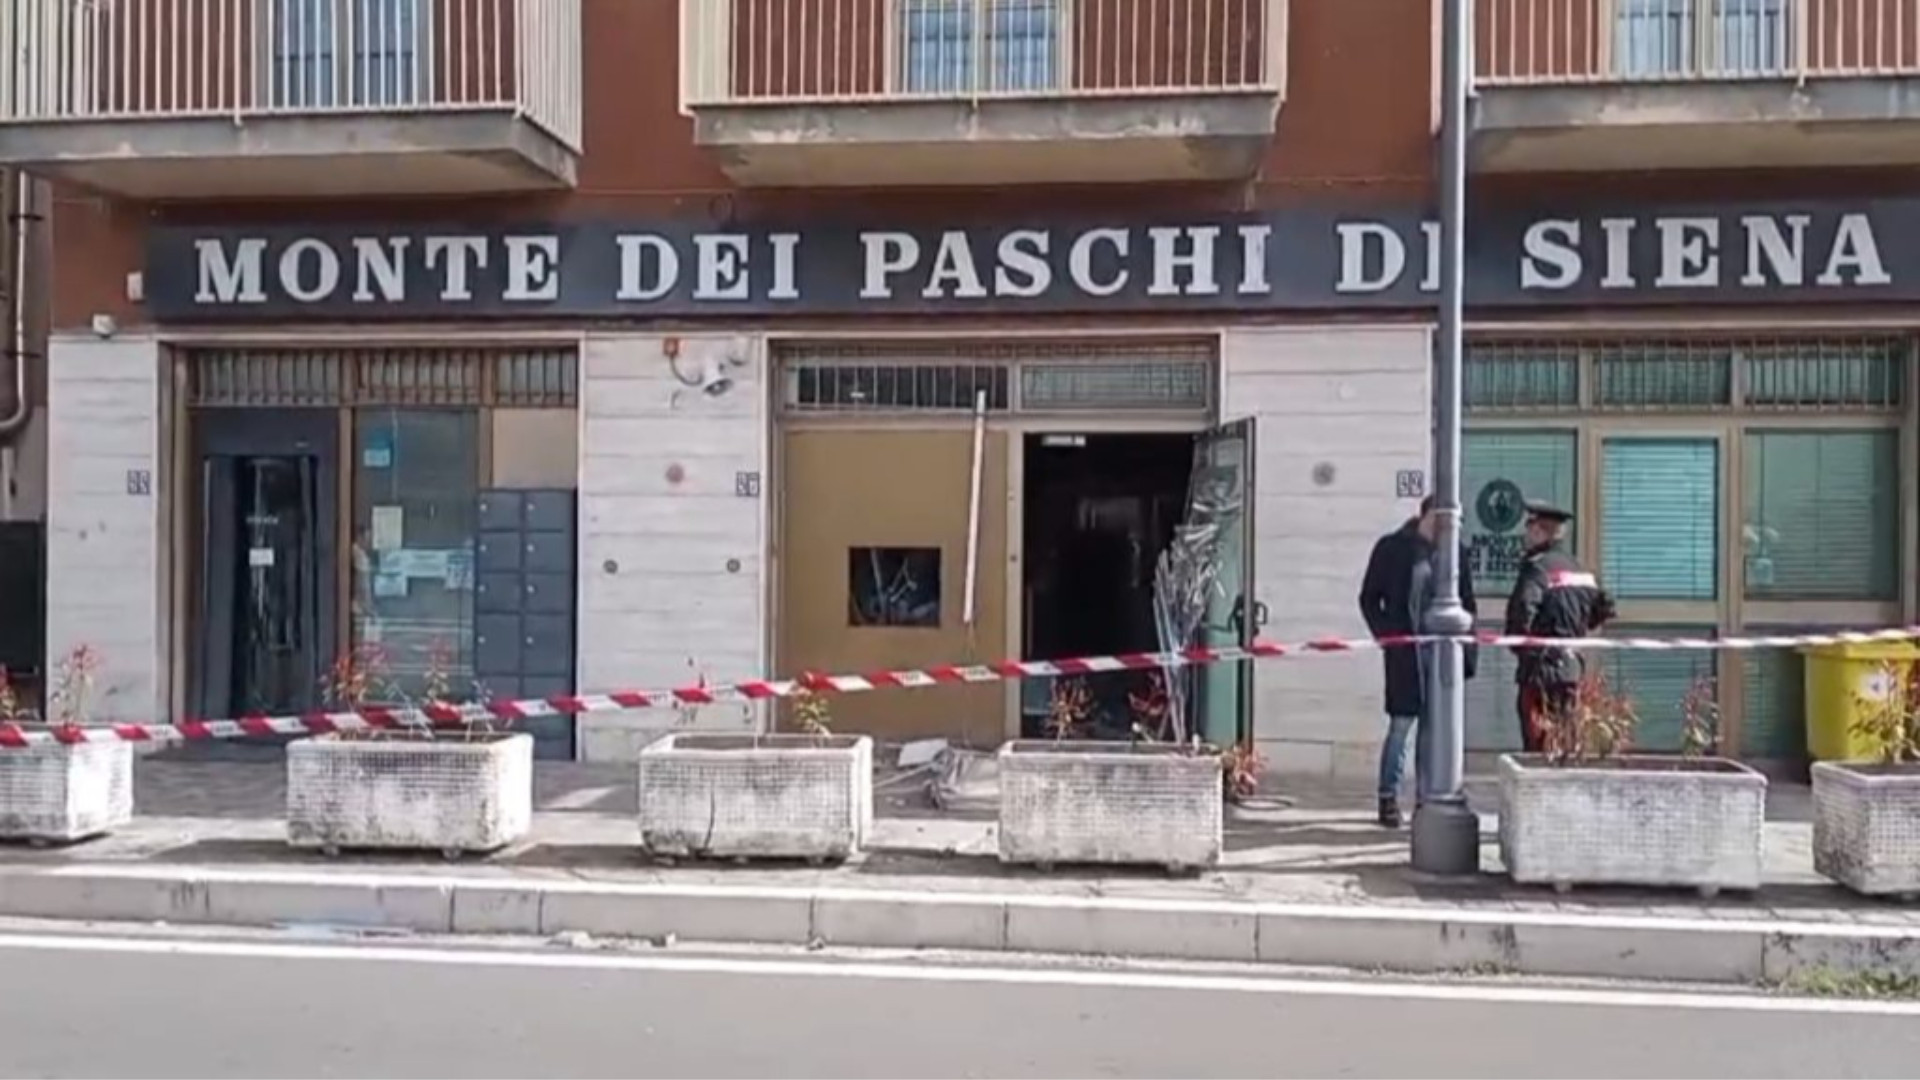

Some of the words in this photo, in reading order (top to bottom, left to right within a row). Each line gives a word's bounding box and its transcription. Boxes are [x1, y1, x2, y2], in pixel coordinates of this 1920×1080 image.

[195, 236, 559, 302] MONTE
[616, 233, 799, 299] DEI
[859, 225, 1271, 298] PASCHI
[1521, 213, 1891, 288] SIENA
